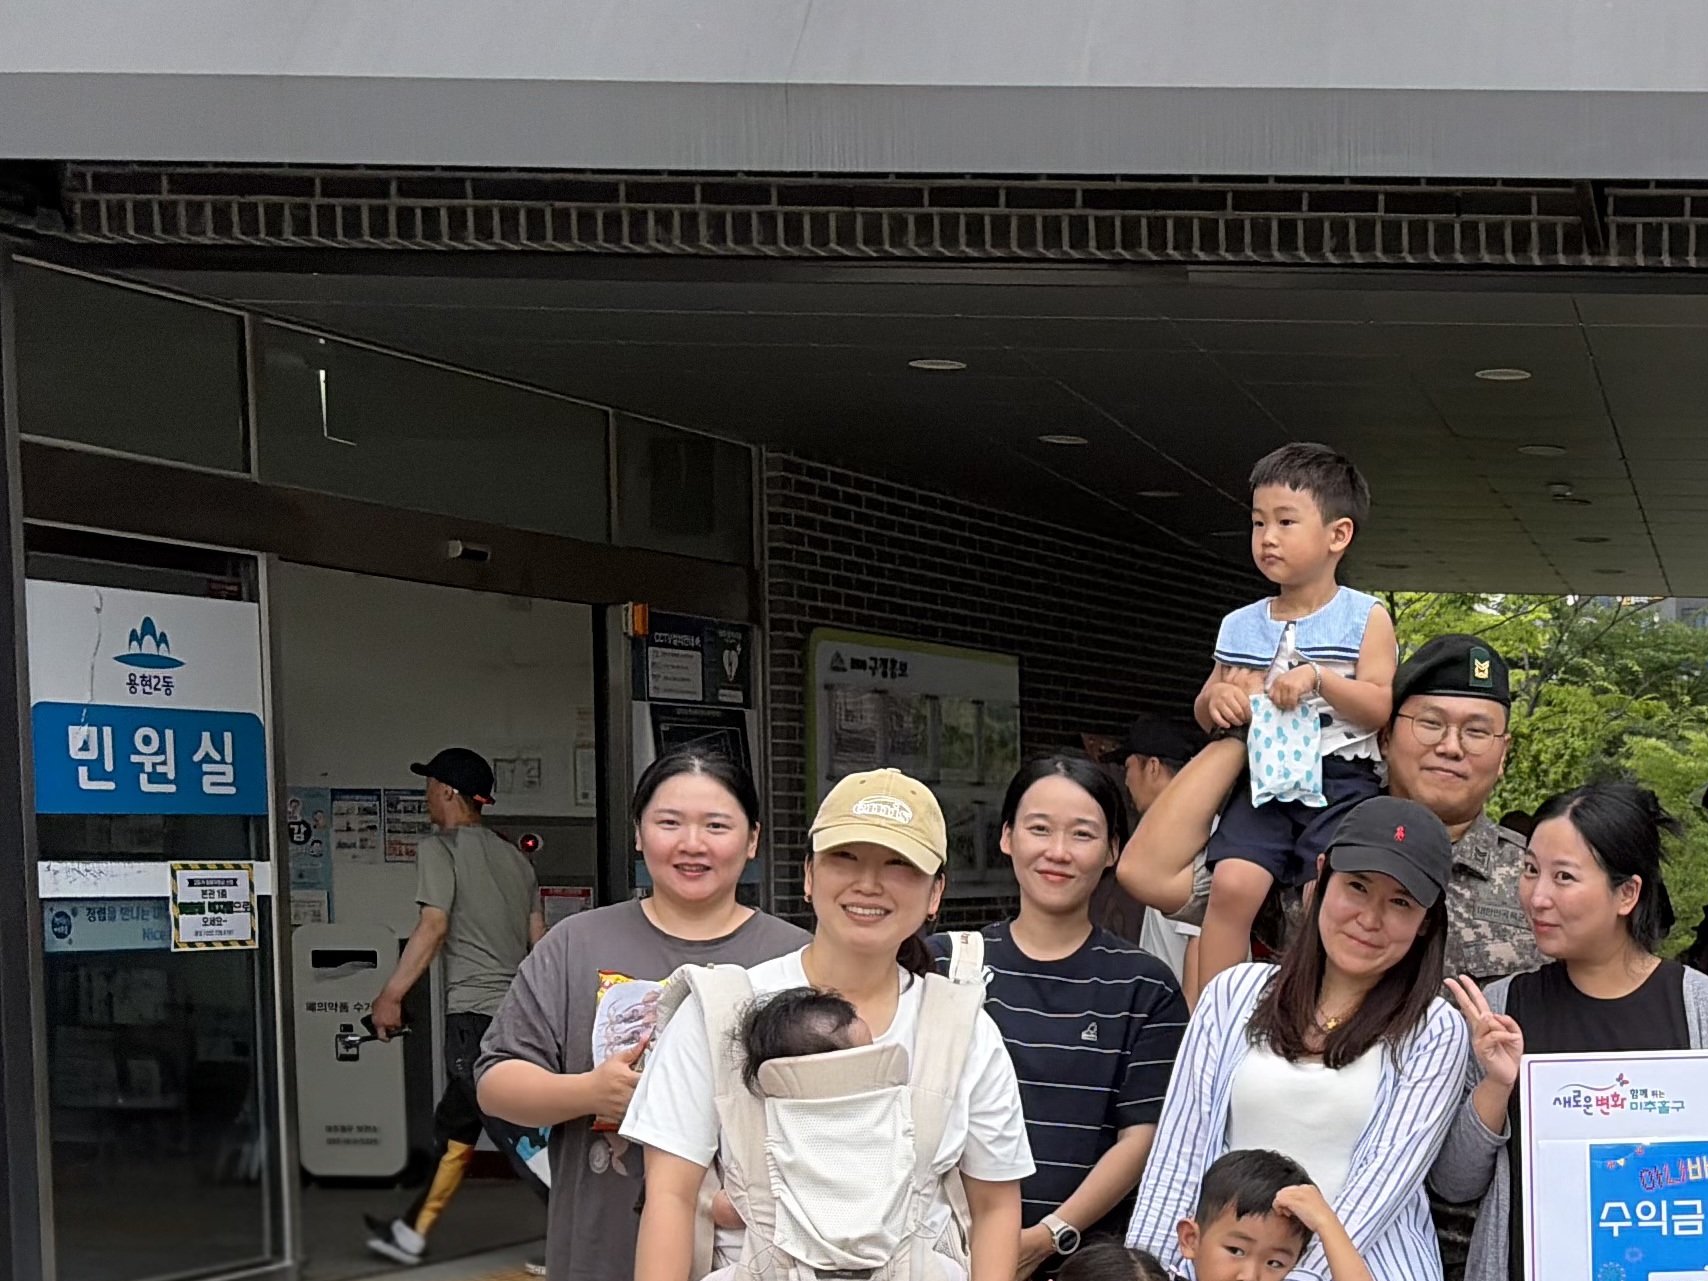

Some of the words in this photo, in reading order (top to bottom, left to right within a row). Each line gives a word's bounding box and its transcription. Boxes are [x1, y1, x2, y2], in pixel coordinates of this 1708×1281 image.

[126, 673, 175, 696] 용현2동
[68, 724, 237, 795] 민원실
[1553, 1090, 1594, 1115] 새로운
[1595, 1091, 1627, 1115] 변화
[1630, 1100, 1685, 1114] 미추홀구
[1599, 1199, 1706, 1238] 수익금
